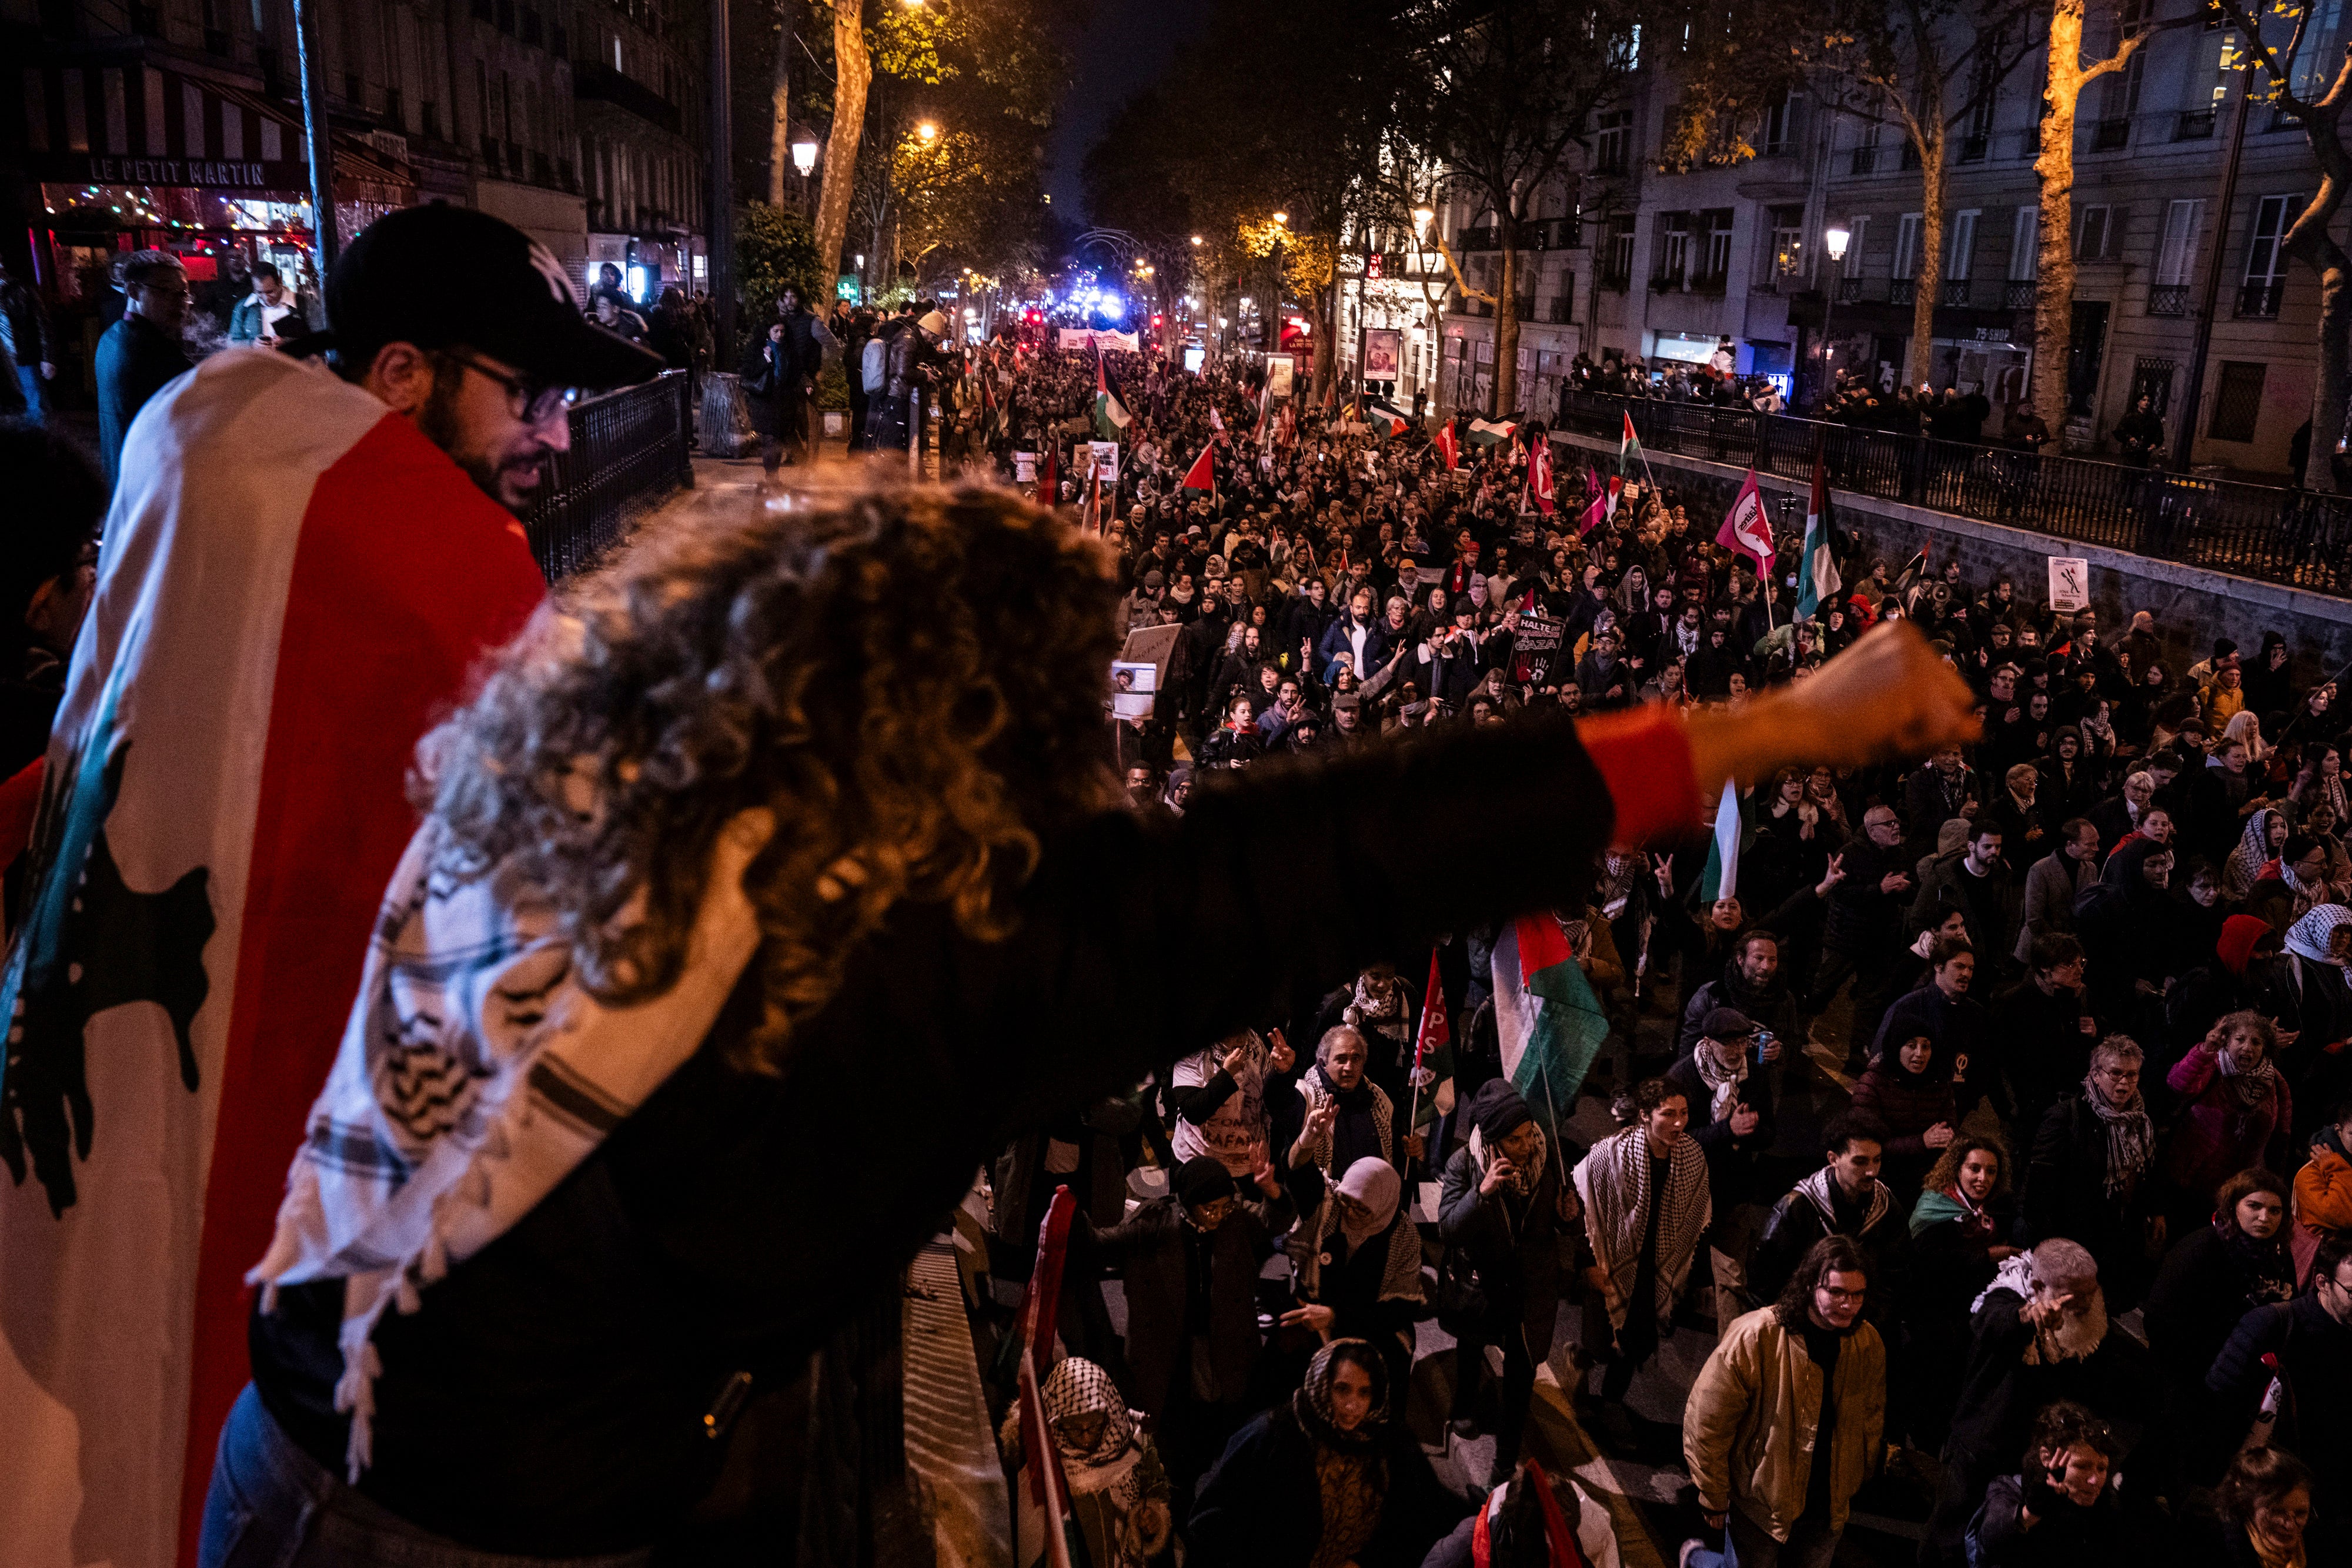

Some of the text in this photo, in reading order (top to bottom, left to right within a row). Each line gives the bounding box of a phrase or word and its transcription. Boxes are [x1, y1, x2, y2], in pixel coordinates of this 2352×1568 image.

[89, 158, 265, 186] LE PETIT MARTIN
[1877, 360, 1895, 394] 75
[1520, 618, 1551, 633] HALTE
[1515, 638, 1558, 651] GAZA
